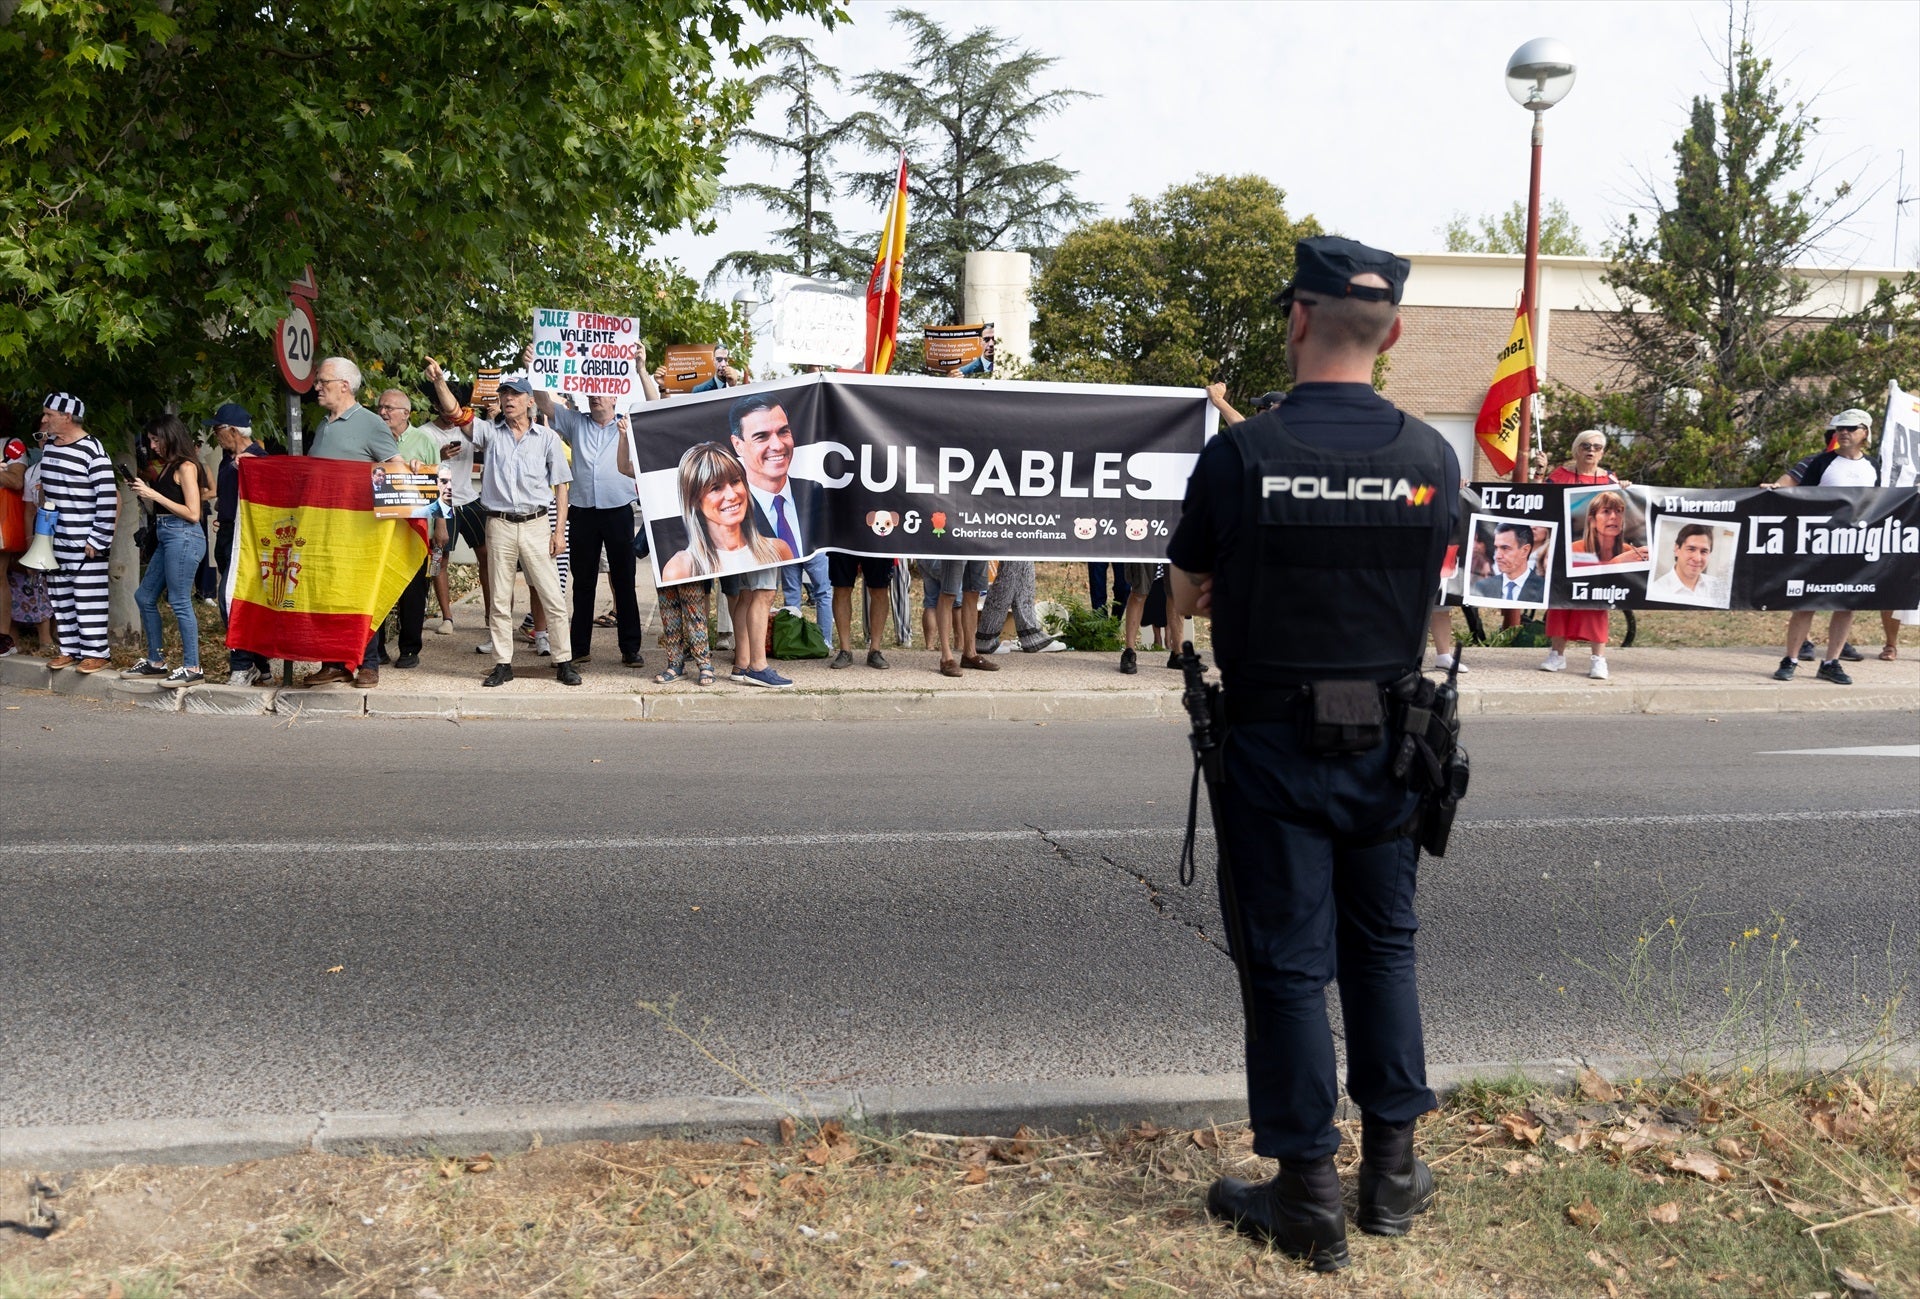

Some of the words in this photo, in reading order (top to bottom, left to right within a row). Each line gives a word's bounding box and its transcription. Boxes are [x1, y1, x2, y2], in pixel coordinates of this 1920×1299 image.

[539, 310, 570, 327] JUEZ
[578, 312, 632, 334] PEINADO
[288, 326, 310, 361] 20
[560, 329, 616, 344] VALIENTE
[536, 340, 561, 356] CON
[592, 344, 636, 360] GORDOS
[534, 358, 558, 374] QUE
[564, 360, 577, 374] EL
[581, 359, 628, 376] CABALLO
[545, 374, 558, 388] DE
[564, 376, 630, 394] ESPARTERO
[813, 441, 1158, 500] CULPABLES
[1262, 476, 1413, 500] POLICIA
[1506, 494, 1544, 514] capo
[1680, 496, 1736, 512] hermano
[958, 512, 981, 524] "LA
[985, 513, 1061, 526] MONCLOA"
[952, 528, 998, 538] Chorizos
[1001, 529, 1013, 539] de
[1015, 529, 1066, 540] confianza
[1746, 516, 1787, 554] La
[1794, 515, 1920, 562] Famiglia
[1572, 582, 1590, 600] La
[1592, 584, 1630, 604] mujer
